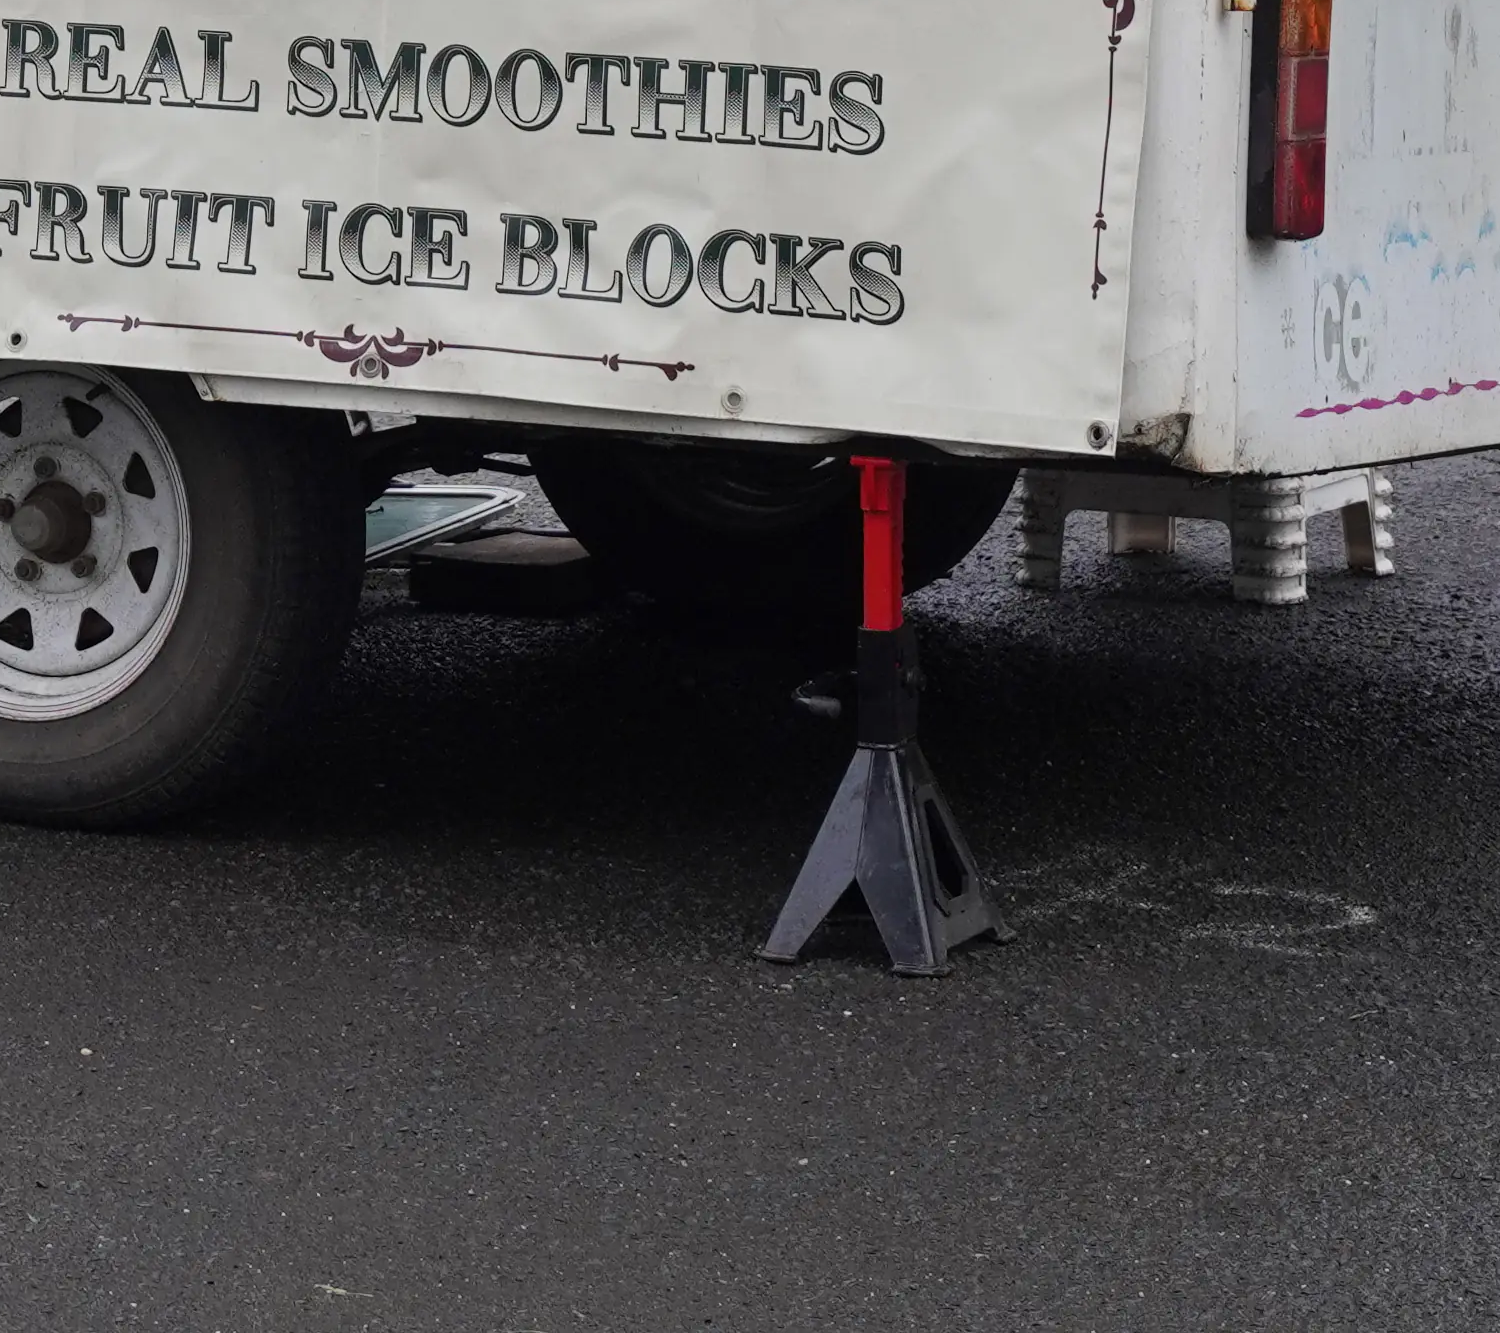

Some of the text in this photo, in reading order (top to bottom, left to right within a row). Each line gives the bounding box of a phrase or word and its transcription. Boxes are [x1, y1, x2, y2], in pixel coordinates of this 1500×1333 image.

[286, 33, 888, 156] SMOOTHIES
[298, 199, 472, 294] ICE
[495, 215, 907, 327] BLOCKS
